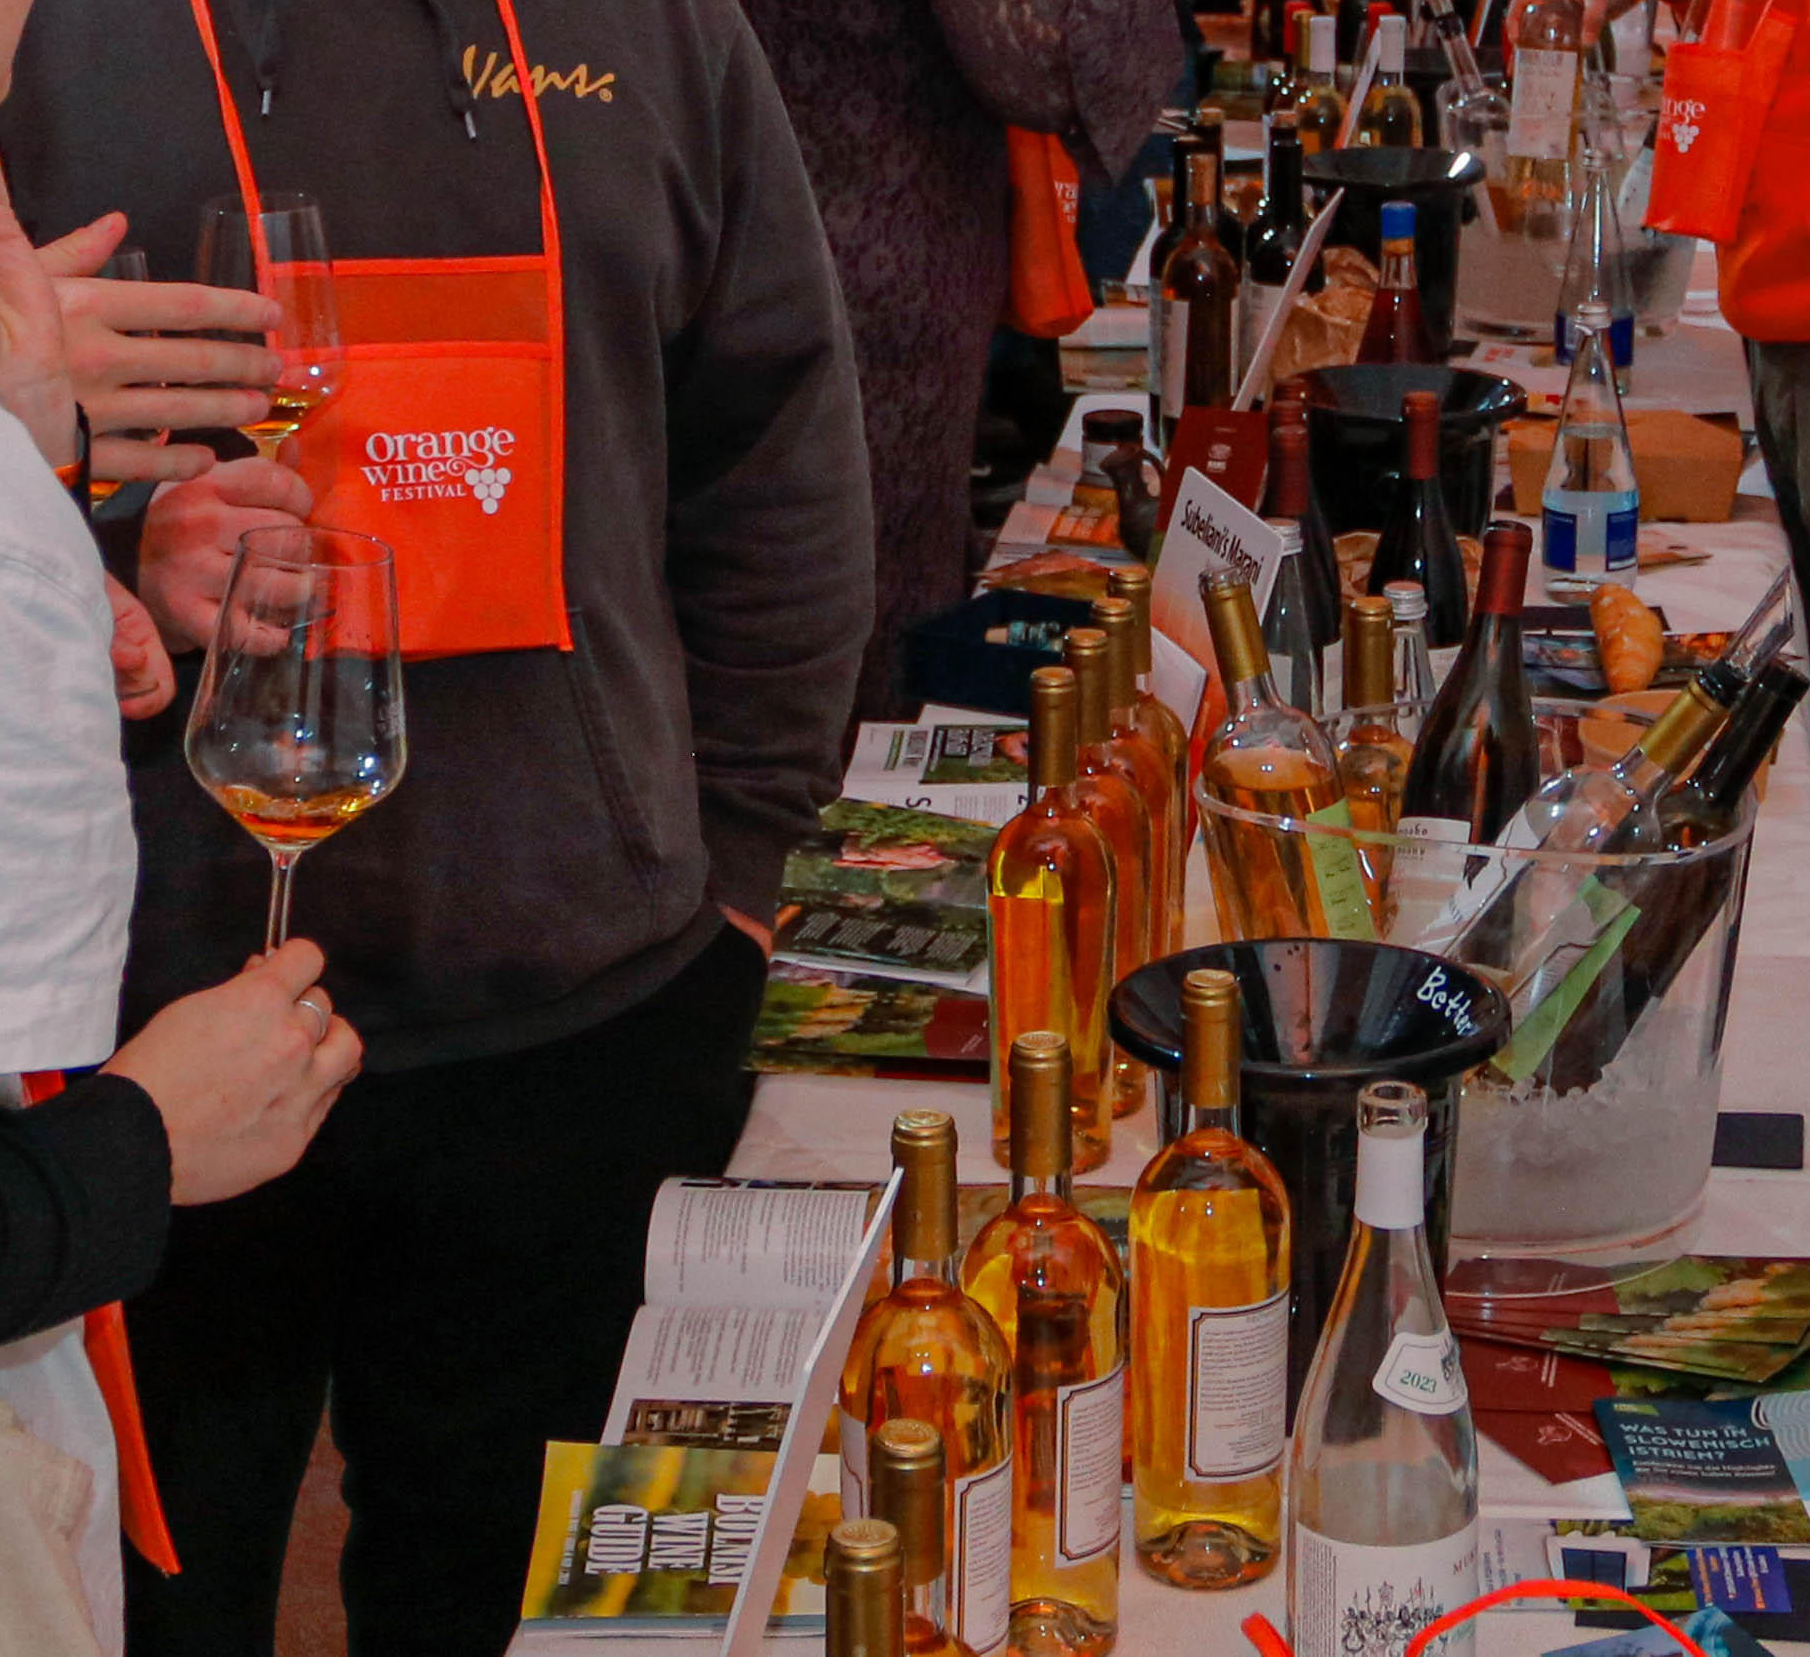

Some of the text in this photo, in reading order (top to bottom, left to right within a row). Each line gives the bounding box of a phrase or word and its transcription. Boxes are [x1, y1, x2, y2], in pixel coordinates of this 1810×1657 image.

[359, 461, 447, 487] wine
[380, 484, 467, 503] FESTIVAL
[1399, 1368, 1438, 1395] 2023
[1619, 1422, 1668, 1437] WAS
[1624, 1434, 1771, 1449] SLOWENISCH
[1628, 1446, 1726, 1460] ISTRIEN?
[584, 1503, 649, 1575] GUIDE
[647, 1511, 710, 1570] WINE
